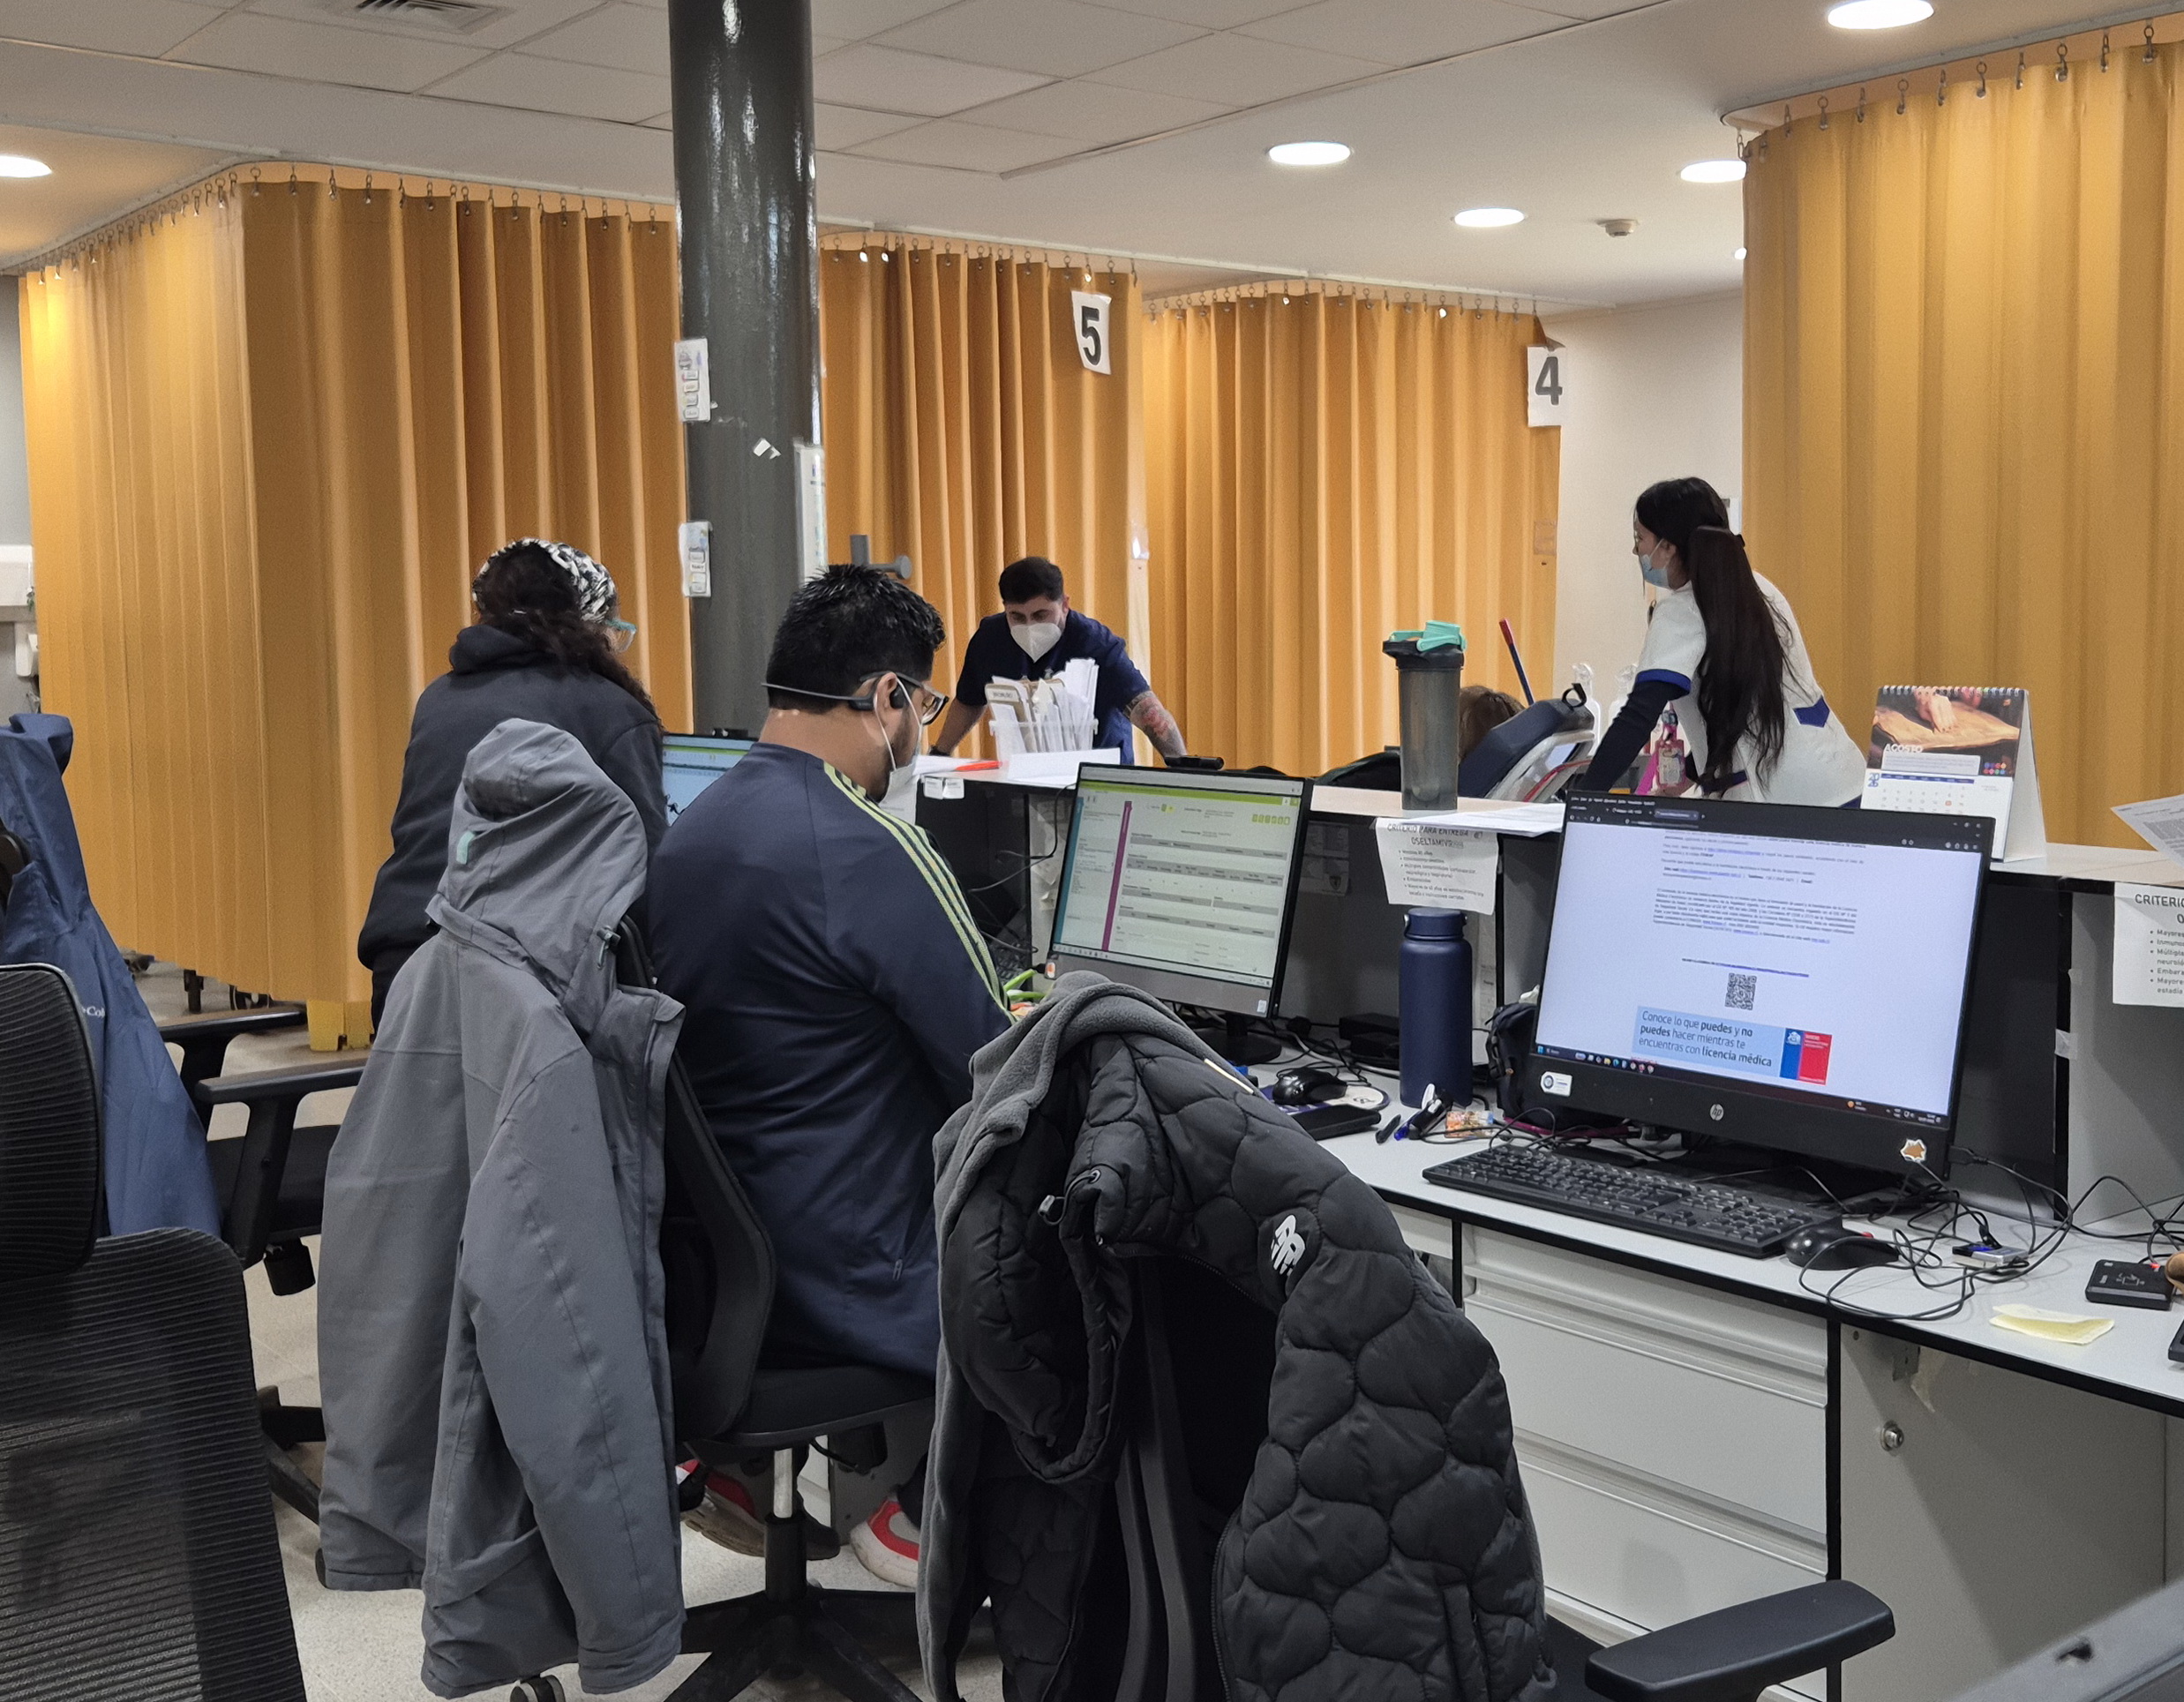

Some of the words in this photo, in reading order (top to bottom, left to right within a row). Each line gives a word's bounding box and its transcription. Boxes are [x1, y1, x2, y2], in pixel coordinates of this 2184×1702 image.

[1082, 305, 1101, 365] 5
[1535, 356, 1563, 405] 4
[1884, 744, 1924, 754] AGOSTO
[1640, 1024, 1670, 1037] puedes
[1672, 1030, 1695, 1041] hacer
[1697, 1033, 1735, 1047] mientras
[1736, 1039, 1745, 1049] te
[1642, 1010, 1672, 1024] Conoce
[1674, 1015, 1682, 1026] lo
[1684, 1019, 1700, 1031] que
[1700, 1021, 1732, 1034] puedes
[1734, 1027, 1740, 1037] y
[1741, 1028, 1753, 1037] no
[1639, 1038, 1684, 1052] encuentras
[1685, 1045, 1700, 1054] con
[1702, 1046, 1737, 1061] licencia
[1738, 1053, 1772, 1067] médica
